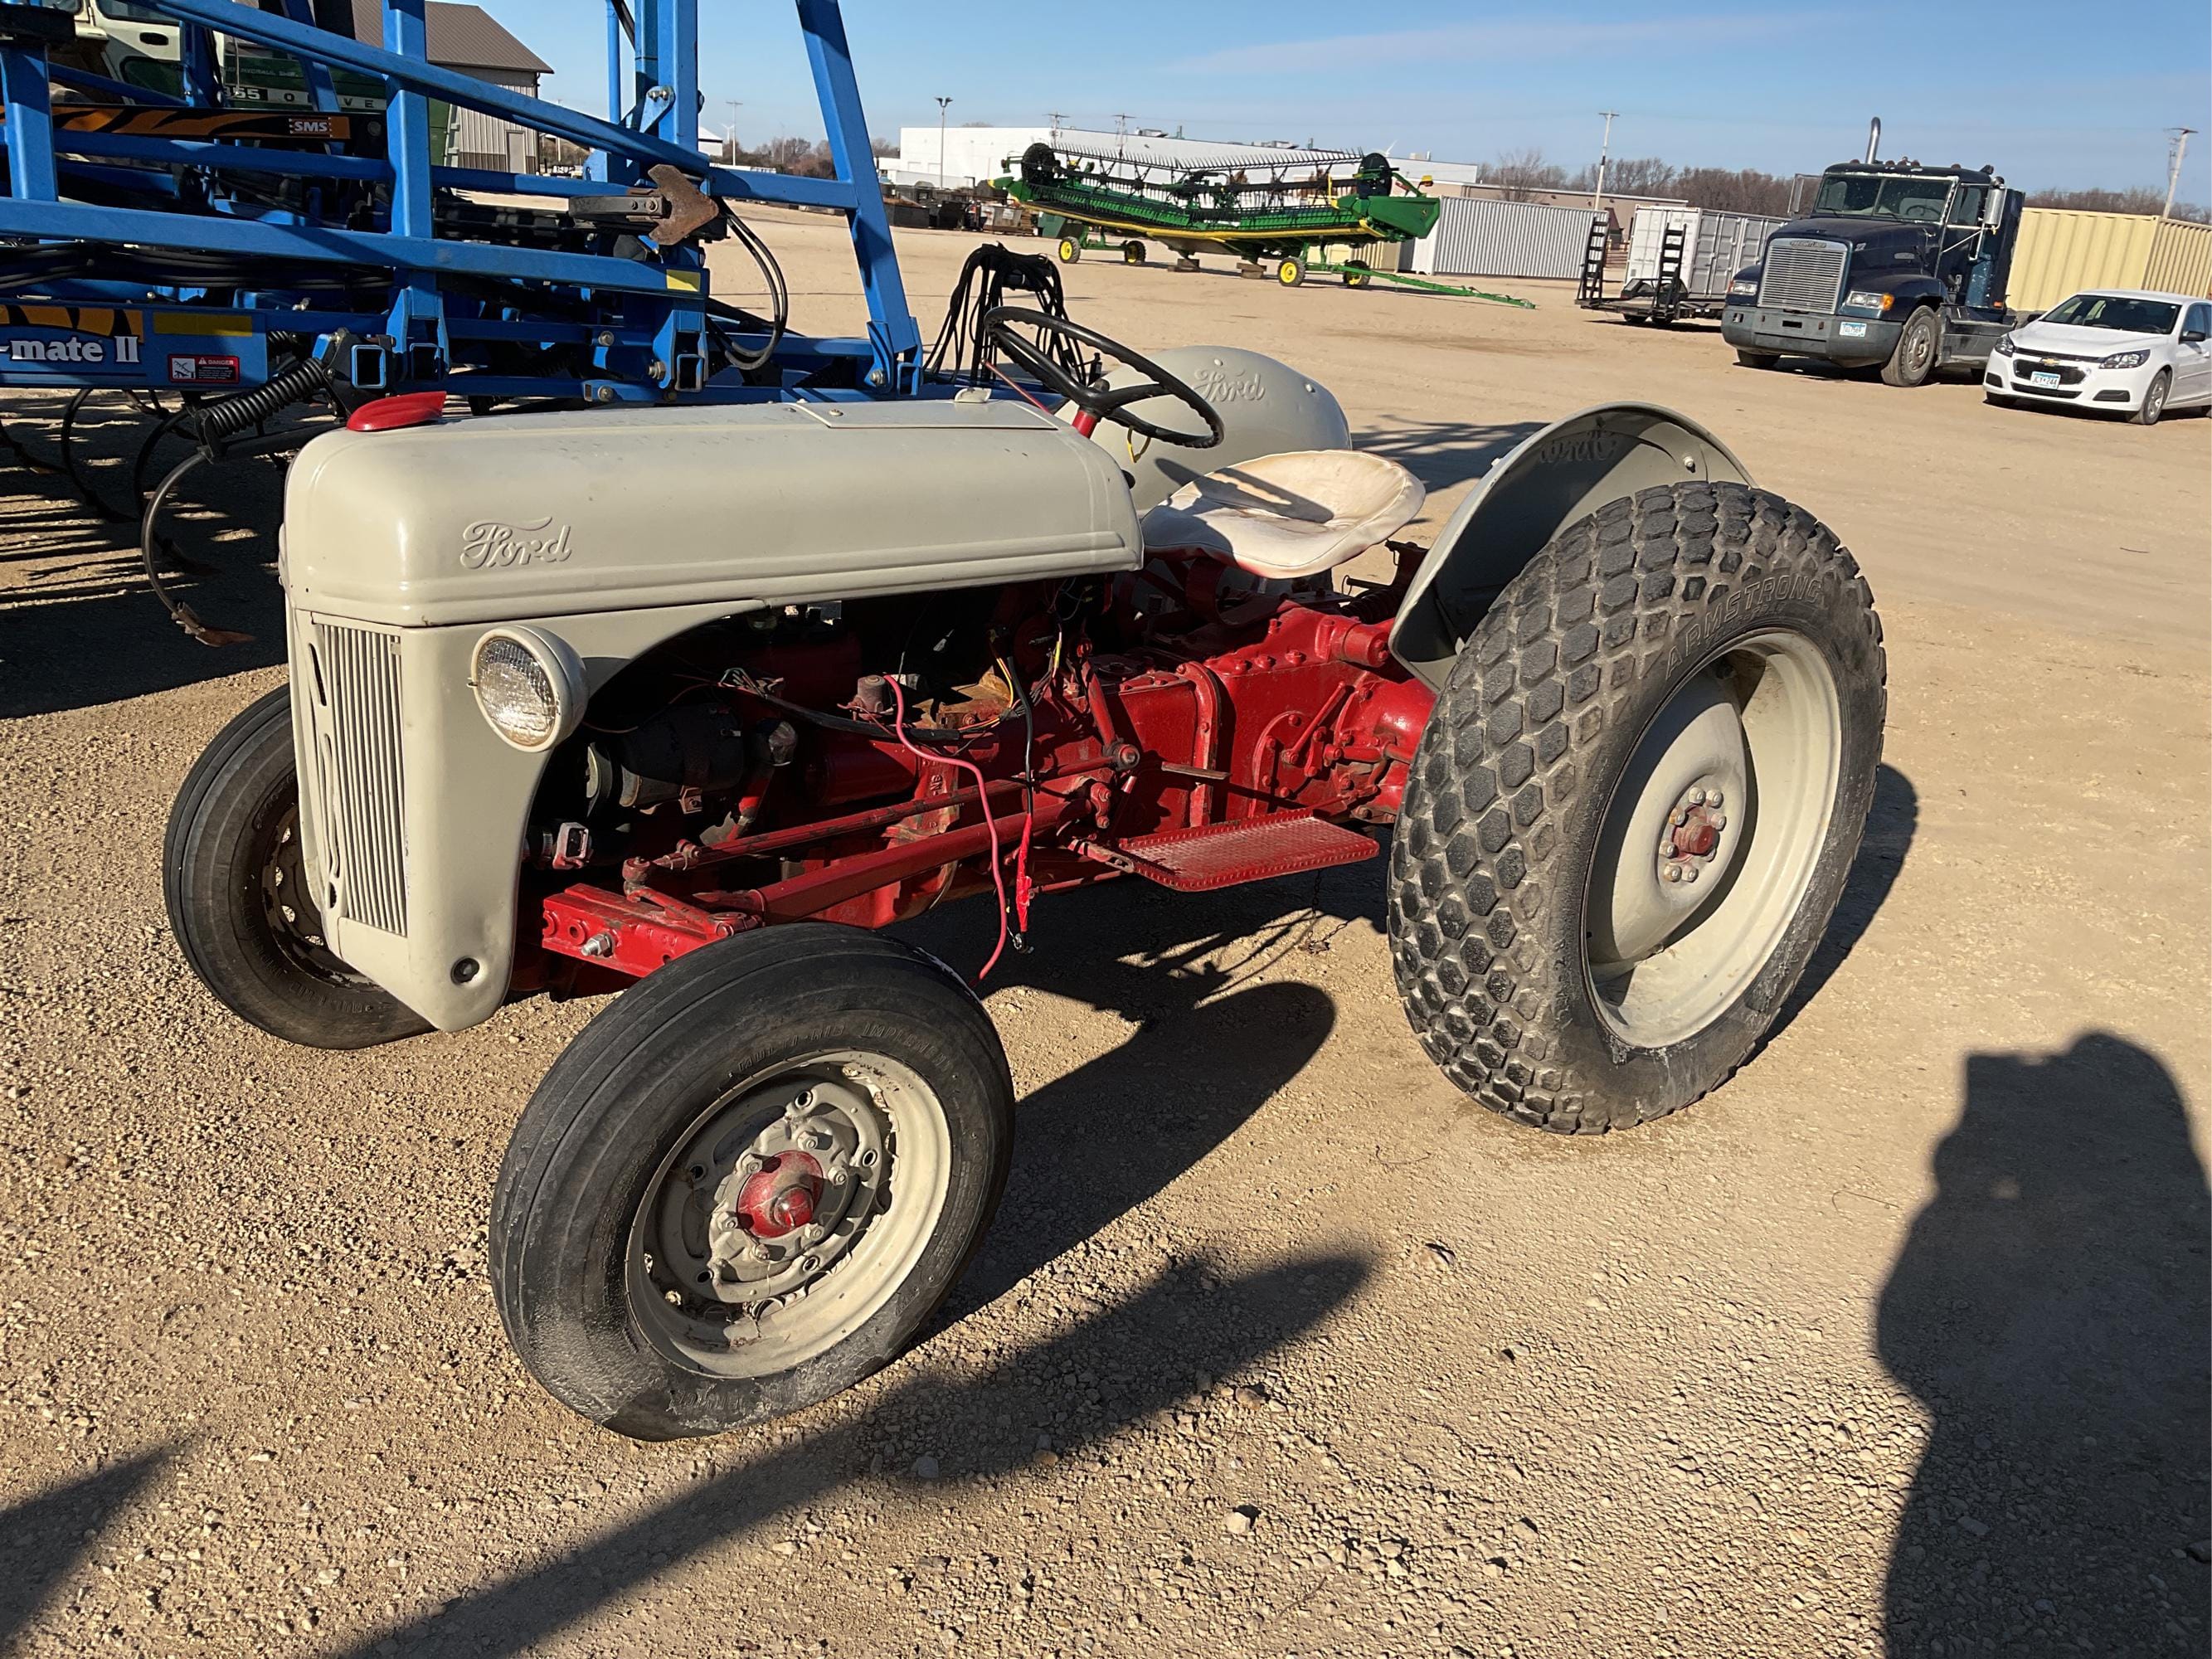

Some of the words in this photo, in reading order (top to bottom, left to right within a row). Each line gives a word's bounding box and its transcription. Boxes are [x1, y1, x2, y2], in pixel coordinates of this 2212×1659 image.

[294, 121, 328, 133] SMS
[114, 336, 140, 362] II
[1194, 368, 1266, 402] Ford
[459, 516, 572, 570] Ford
[1665, 575, 1823, 680] ARMSTRONG
